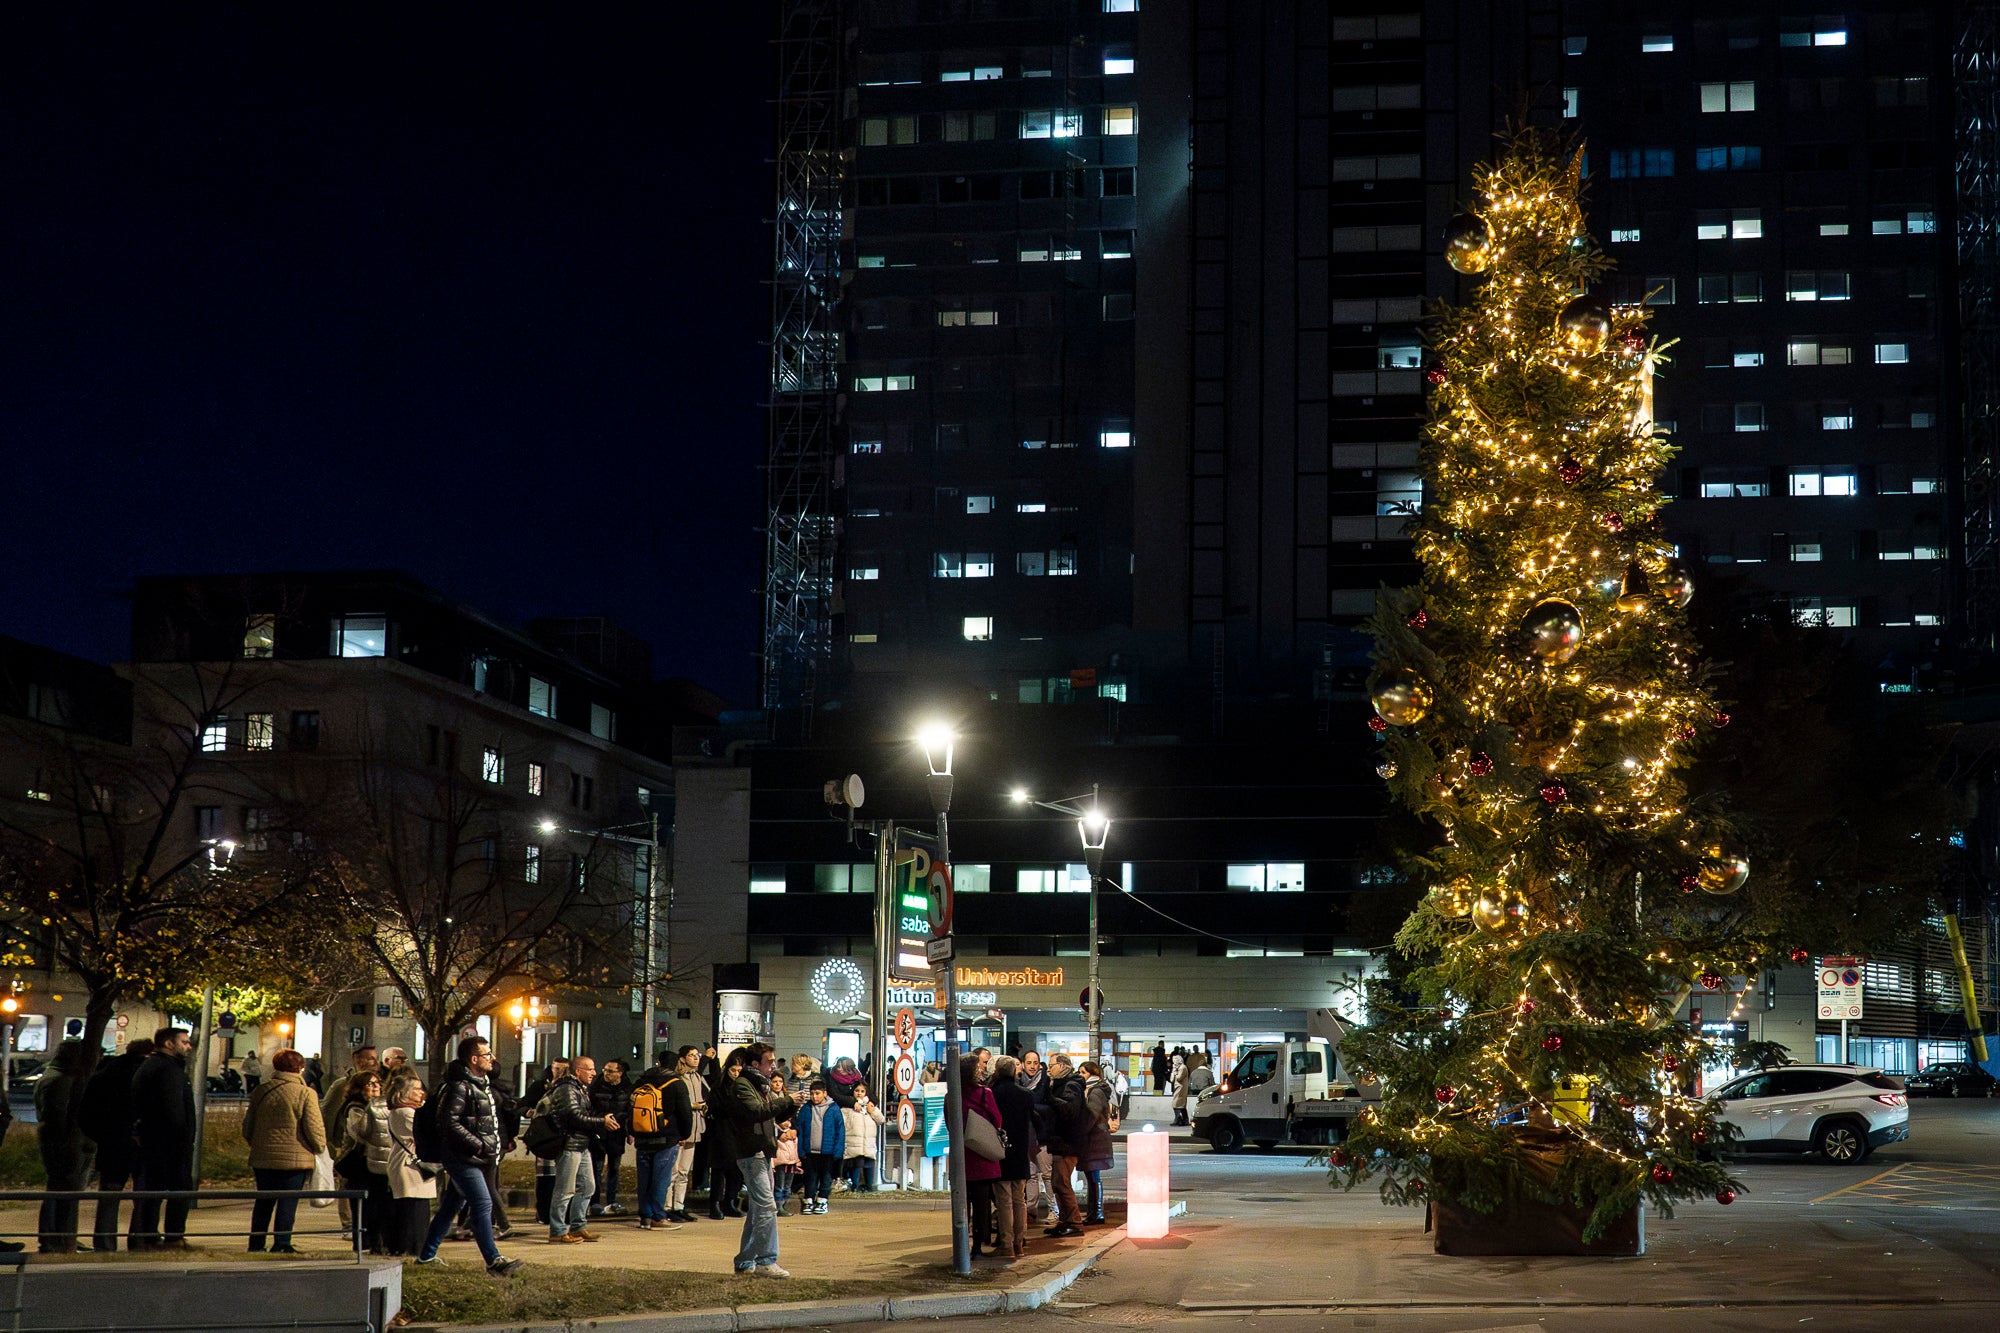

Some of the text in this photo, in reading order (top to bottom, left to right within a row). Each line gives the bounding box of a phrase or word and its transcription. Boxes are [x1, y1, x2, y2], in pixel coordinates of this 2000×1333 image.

[908, 846, 931, 893] P
[901, 914, 929, 934] saba
[956, 968, 1063, 986] Universitari
[900, 1067, 911, 1082] 10
